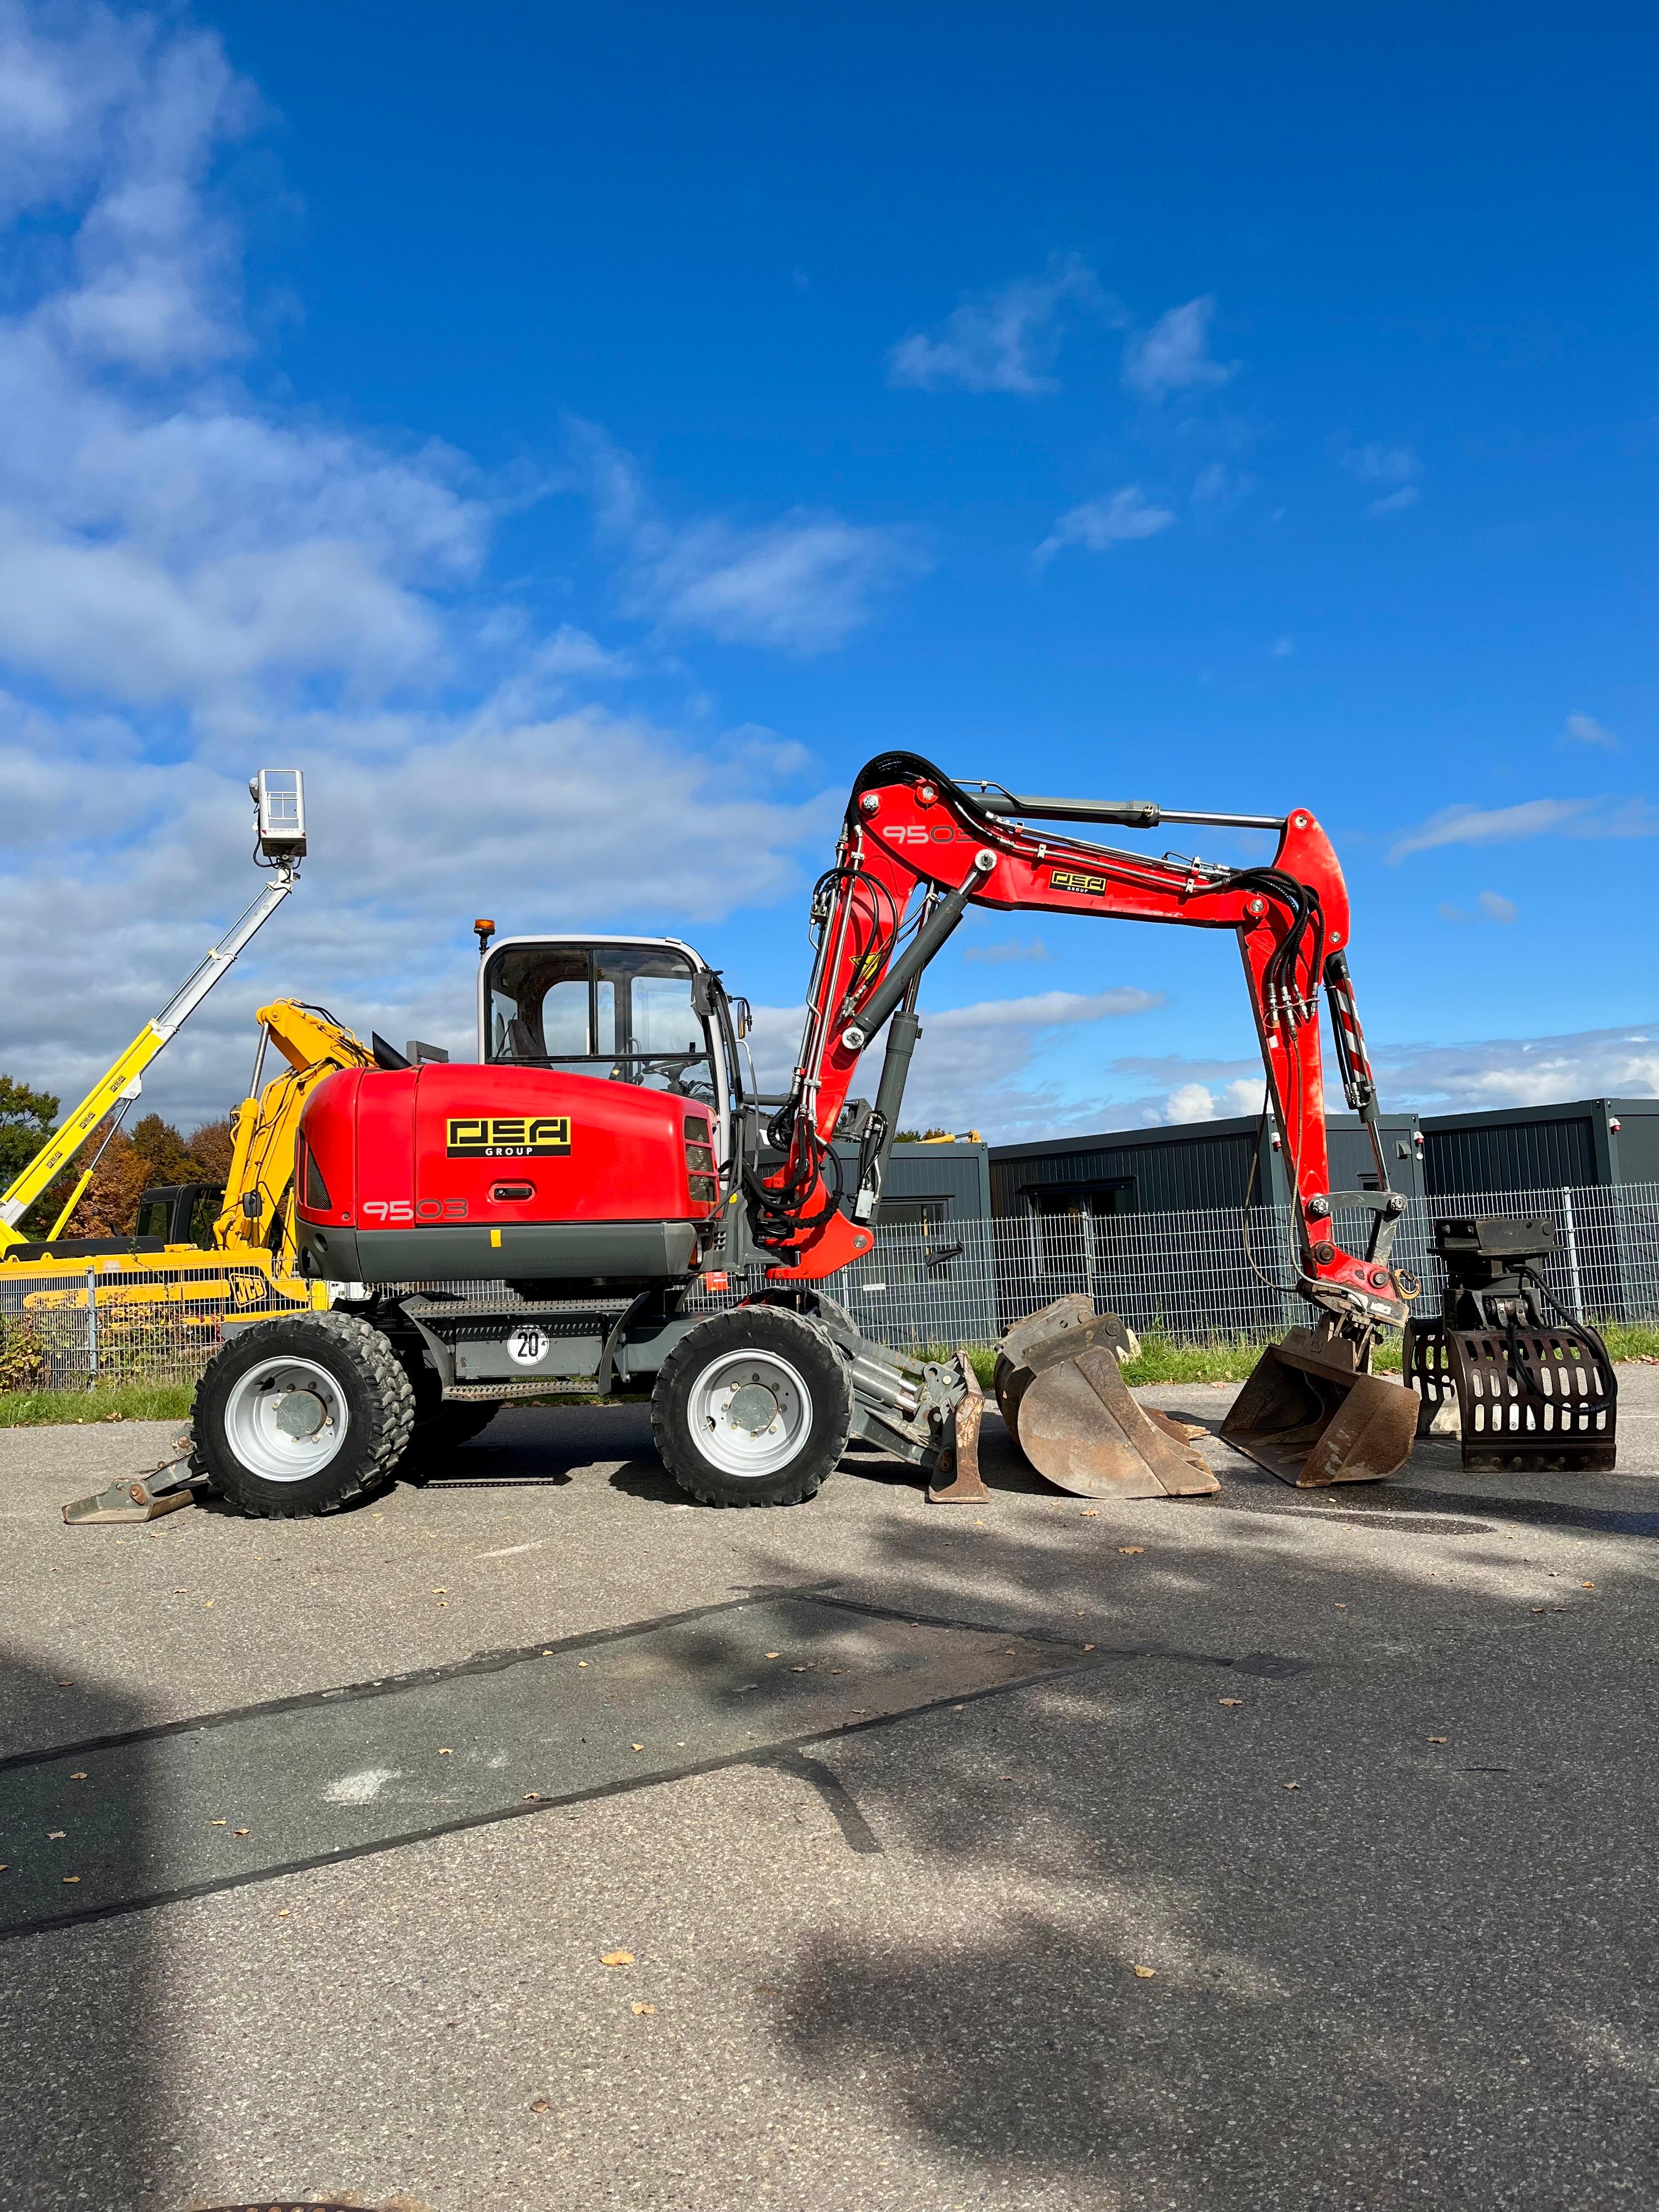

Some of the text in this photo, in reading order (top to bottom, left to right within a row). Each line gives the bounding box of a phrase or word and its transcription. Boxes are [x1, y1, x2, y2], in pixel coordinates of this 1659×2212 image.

[486, 1147, 533, 1156] GROUP
[363, 1199, 468, 1221] 9503
[235, 1277, 264, 1302] JCB
[518, 1332, 539, 1357] 20
